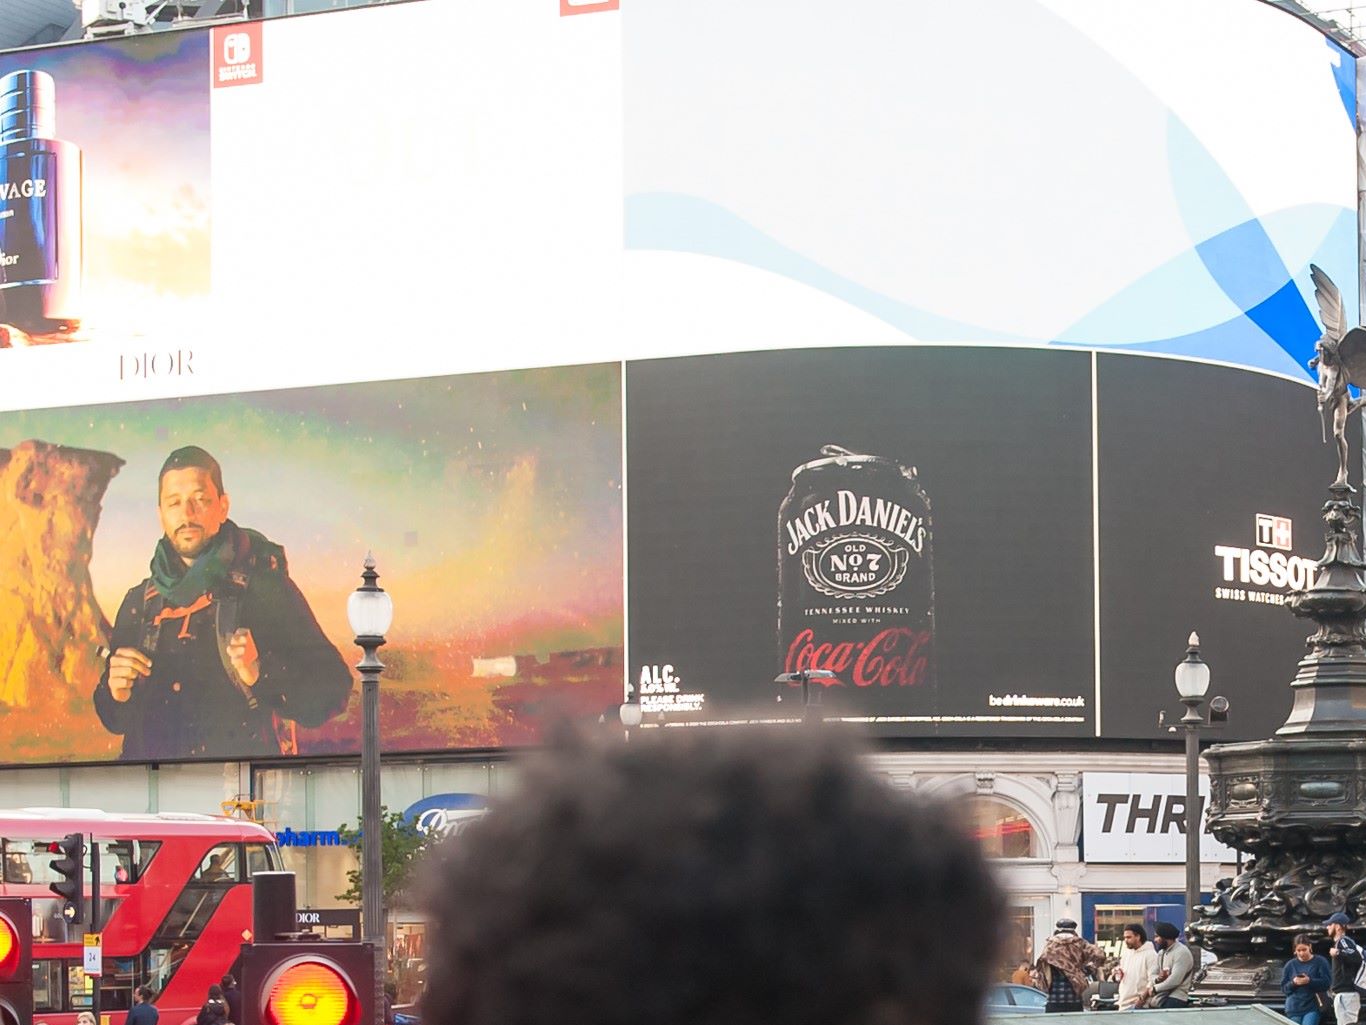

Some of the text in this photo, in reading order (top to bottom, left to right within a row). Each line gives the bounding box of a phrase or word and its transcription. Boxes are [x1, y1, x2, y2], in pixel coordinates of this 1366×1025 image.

[120, 349, 194, 380] DIOR
[786, 489, 926, 555] JACK DANIEL'S
[844, 544, 866, 552] OLD
[835, 572, 876, 583] BRAND
[1214, 545, 1317, 592] TISSOT
[1215, 587, 1285, 606] SWISS WATCHES
[804, 606, 910, 616] TENNESSEE WHISKEY
[640, 664, 680, 684] ALC.
[1096, 793, 1212, 835] THR
[276, 827, 363, 848] pharm
[295, 912, 320, 923] DIOR
